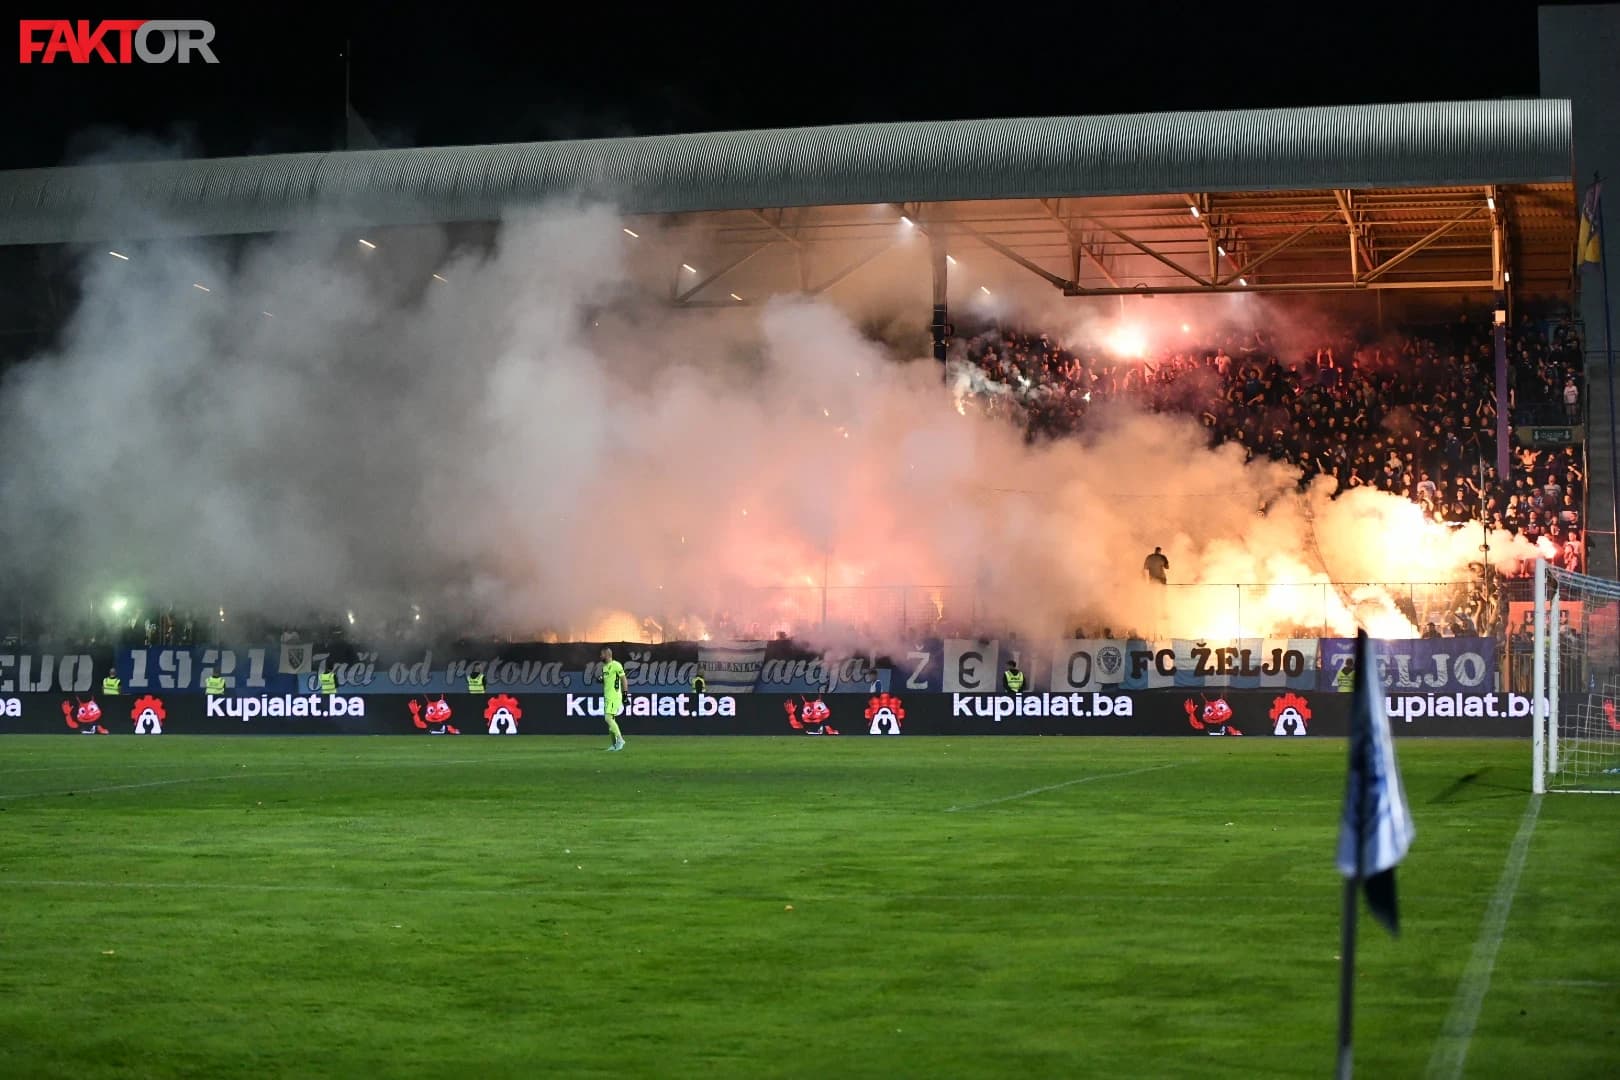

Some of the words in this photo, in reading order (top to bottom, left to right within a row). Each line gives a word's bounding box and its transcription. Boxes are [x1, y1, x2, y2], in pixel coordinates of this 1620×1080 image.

[129, 649, 266, 688] 1921
[389, 650, 432, 685] od
[1130, 649, 1176, 679] FC
[1191, 643, 1305, 677] ŽELJO
[207, 693, 365, 722] kupialat.ba
[566, 693, 736, 717] kuialat.ba
[953, 693, 1133, 721] kupialat.ba
[1385, 693, 1550, 723] upialat.ba
